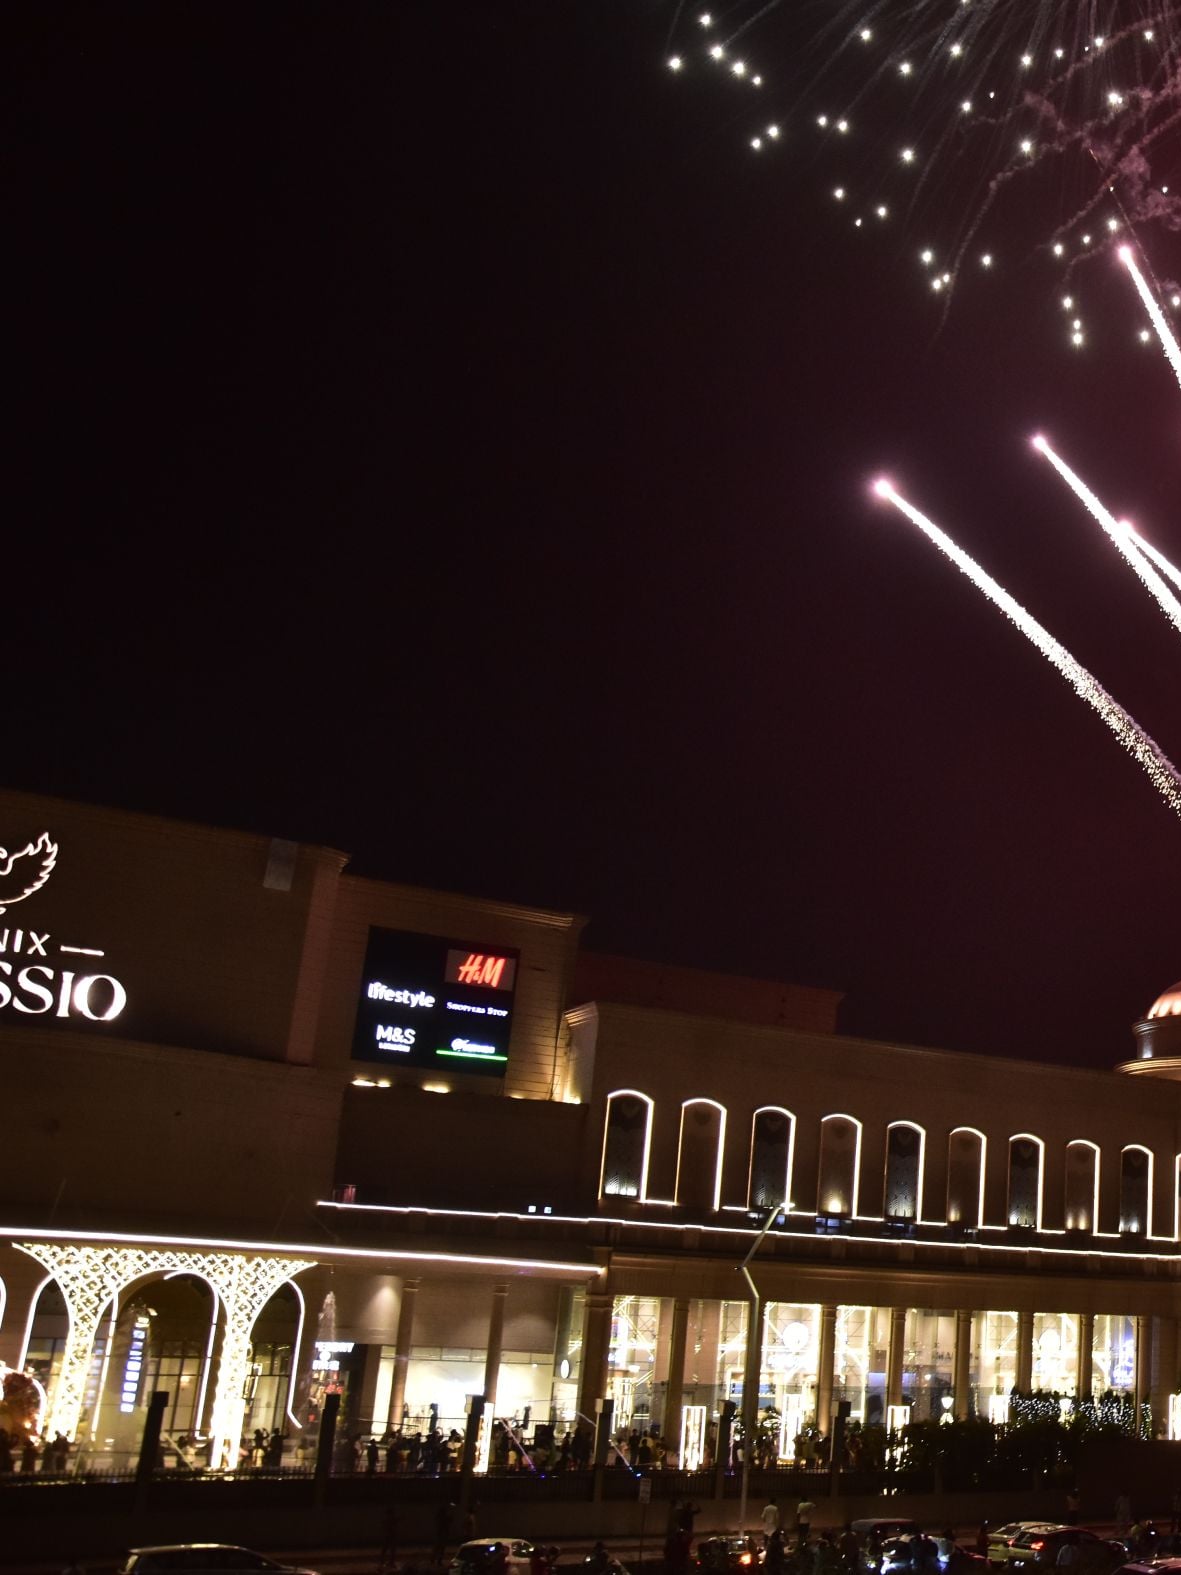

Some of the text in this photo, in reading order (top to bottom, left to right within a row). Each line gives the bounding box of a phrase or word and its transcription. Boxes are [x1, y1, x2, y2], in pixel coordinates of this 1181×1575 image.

[458, 954, 506, 988] H&M
[367, 982, 436, 1008] lifestyle
[376, 1024, 416, 1045] M&S
